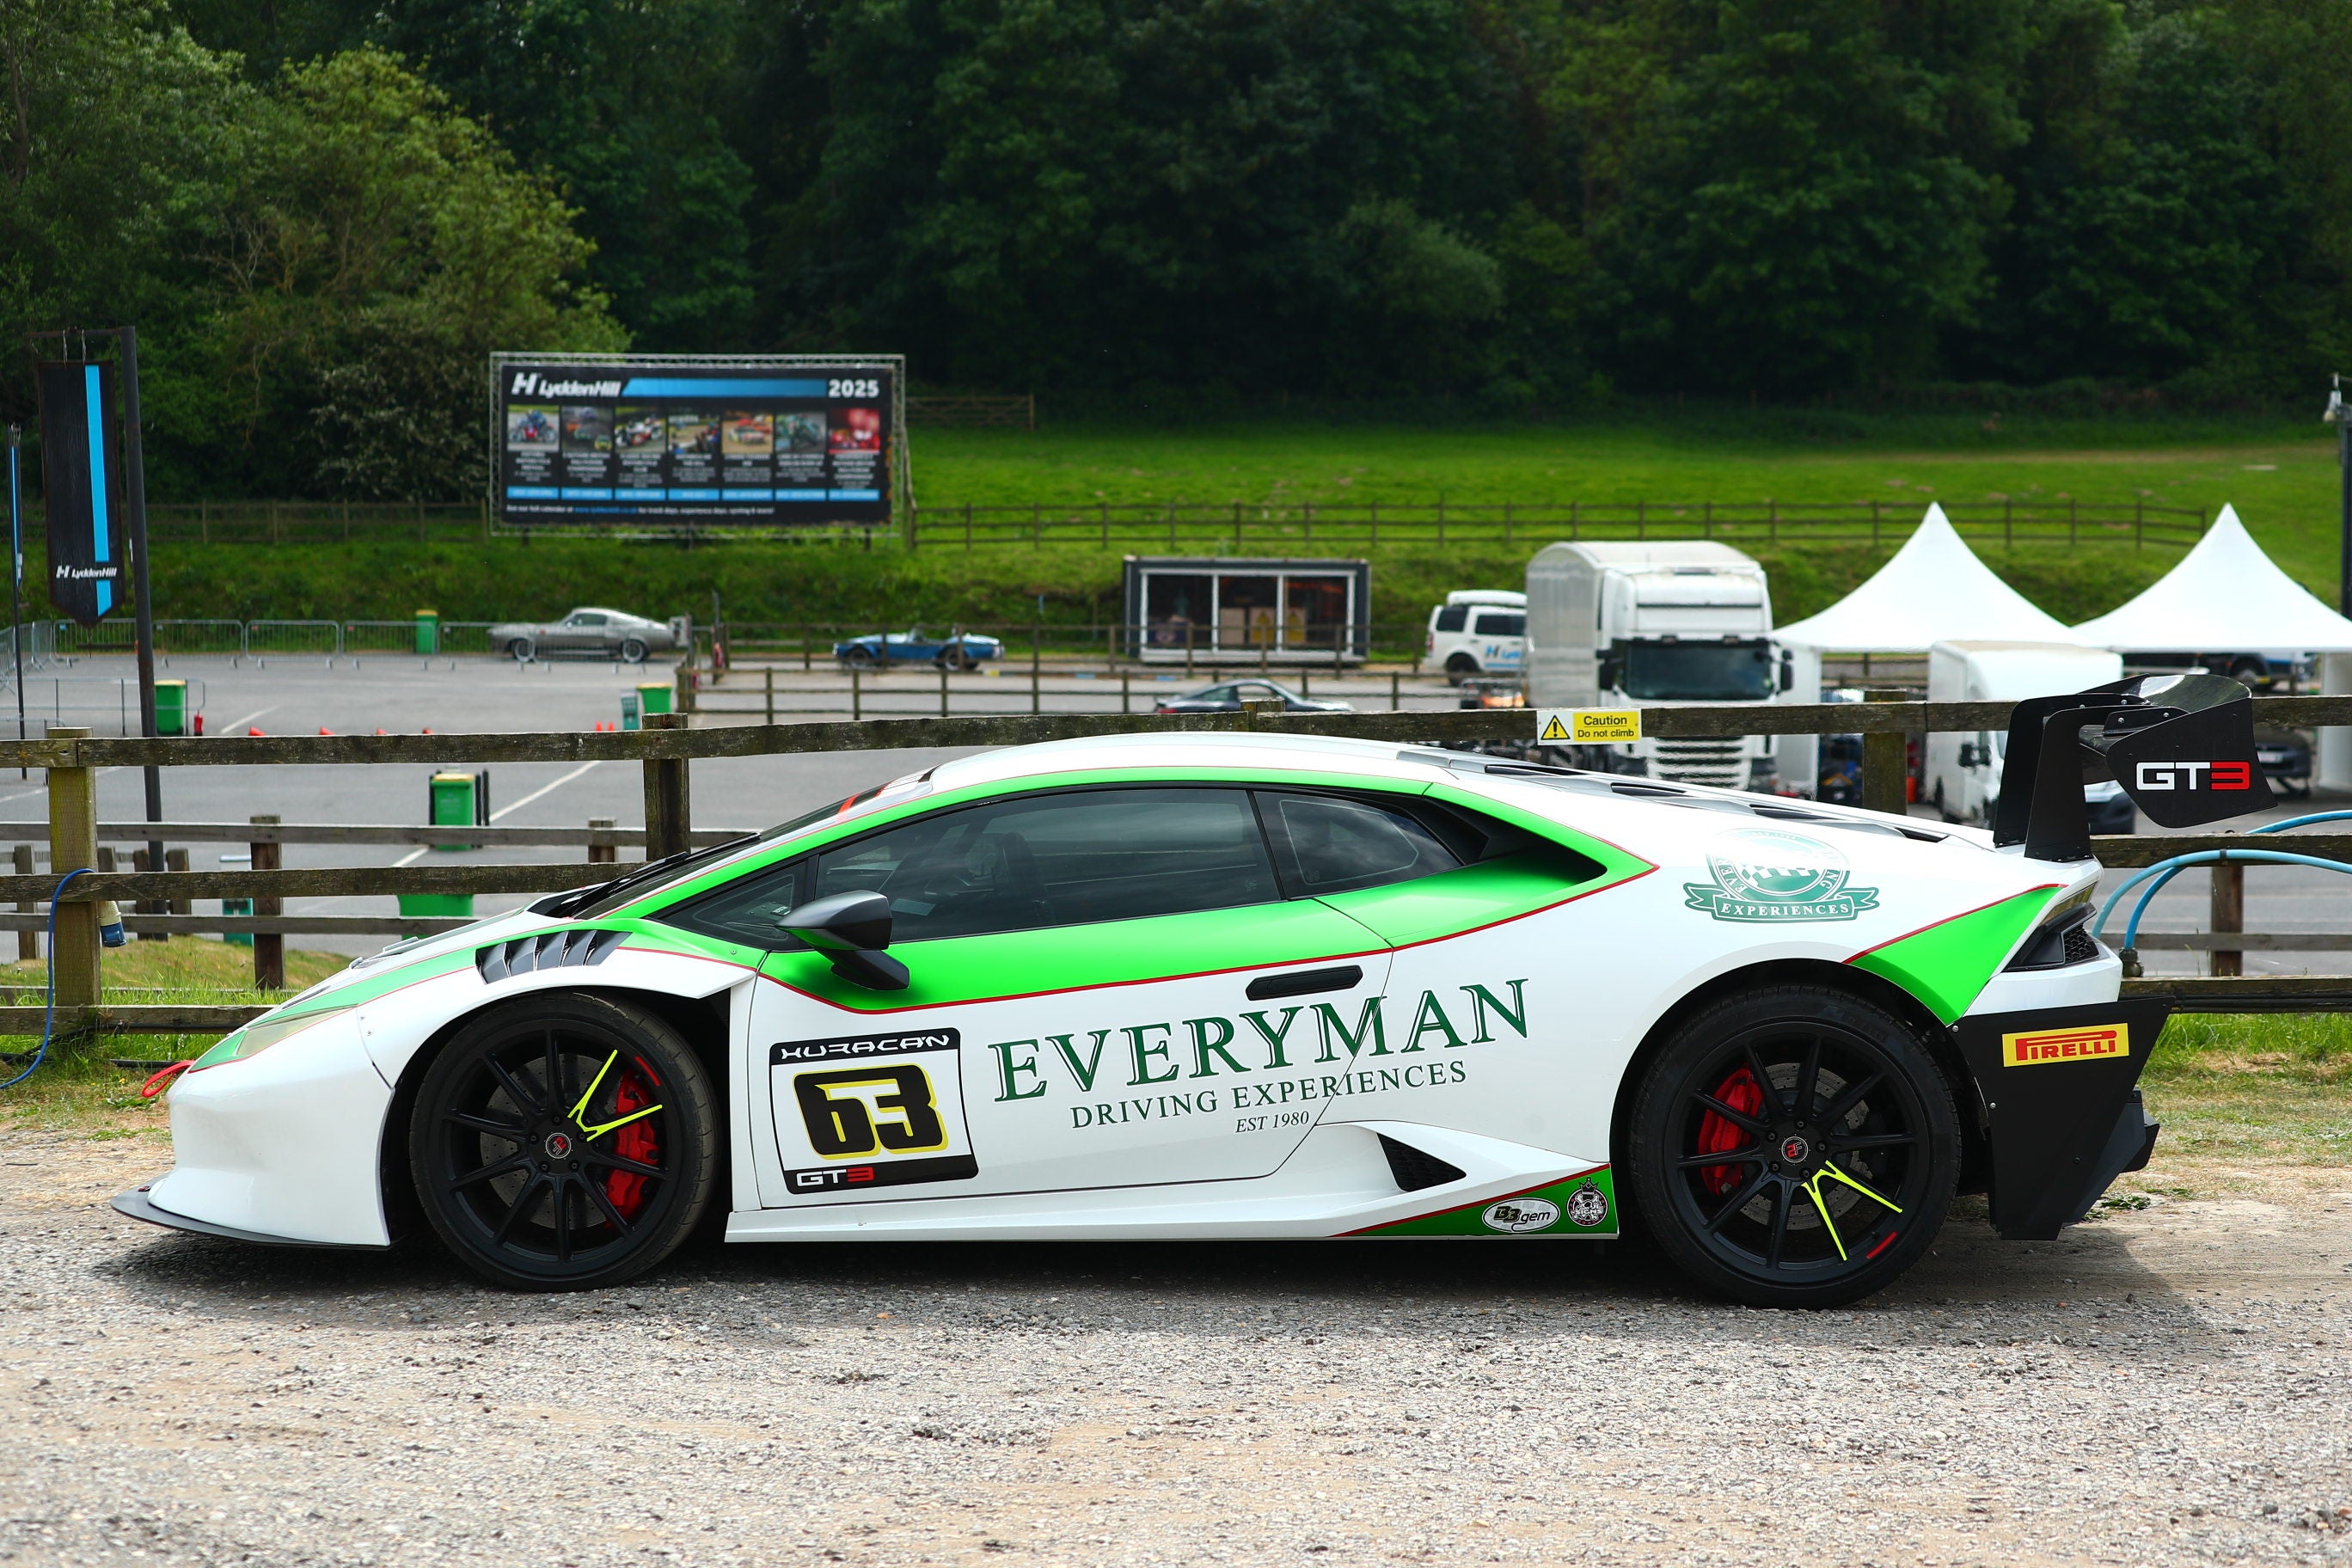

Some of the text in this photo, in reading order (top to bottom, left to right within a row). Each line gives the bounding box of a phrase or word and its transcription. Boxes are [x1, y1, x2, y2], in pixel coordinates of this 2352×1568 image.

[828, 378, 879, 399] 2025
[1583, 714, 1627, 726] Caution
[1577, 728, 1634, 738] Do not climb
[2136, 762, 2251, 790] GT3
[1720, 903, 1849, 916] EXPERIENCES
[988, 978, 1529, 1103] EVERYMAN
[2016, 1030, 2117, 1062] PIRELLI
[1069, 1060, 1467, 1129] DRIVING EXPERIENCES
[792, 1063, 949, 1161] 63
[1235, 1111, 1310, 1133] EST 1980
[796, 1167, 874, 1187] GT3
